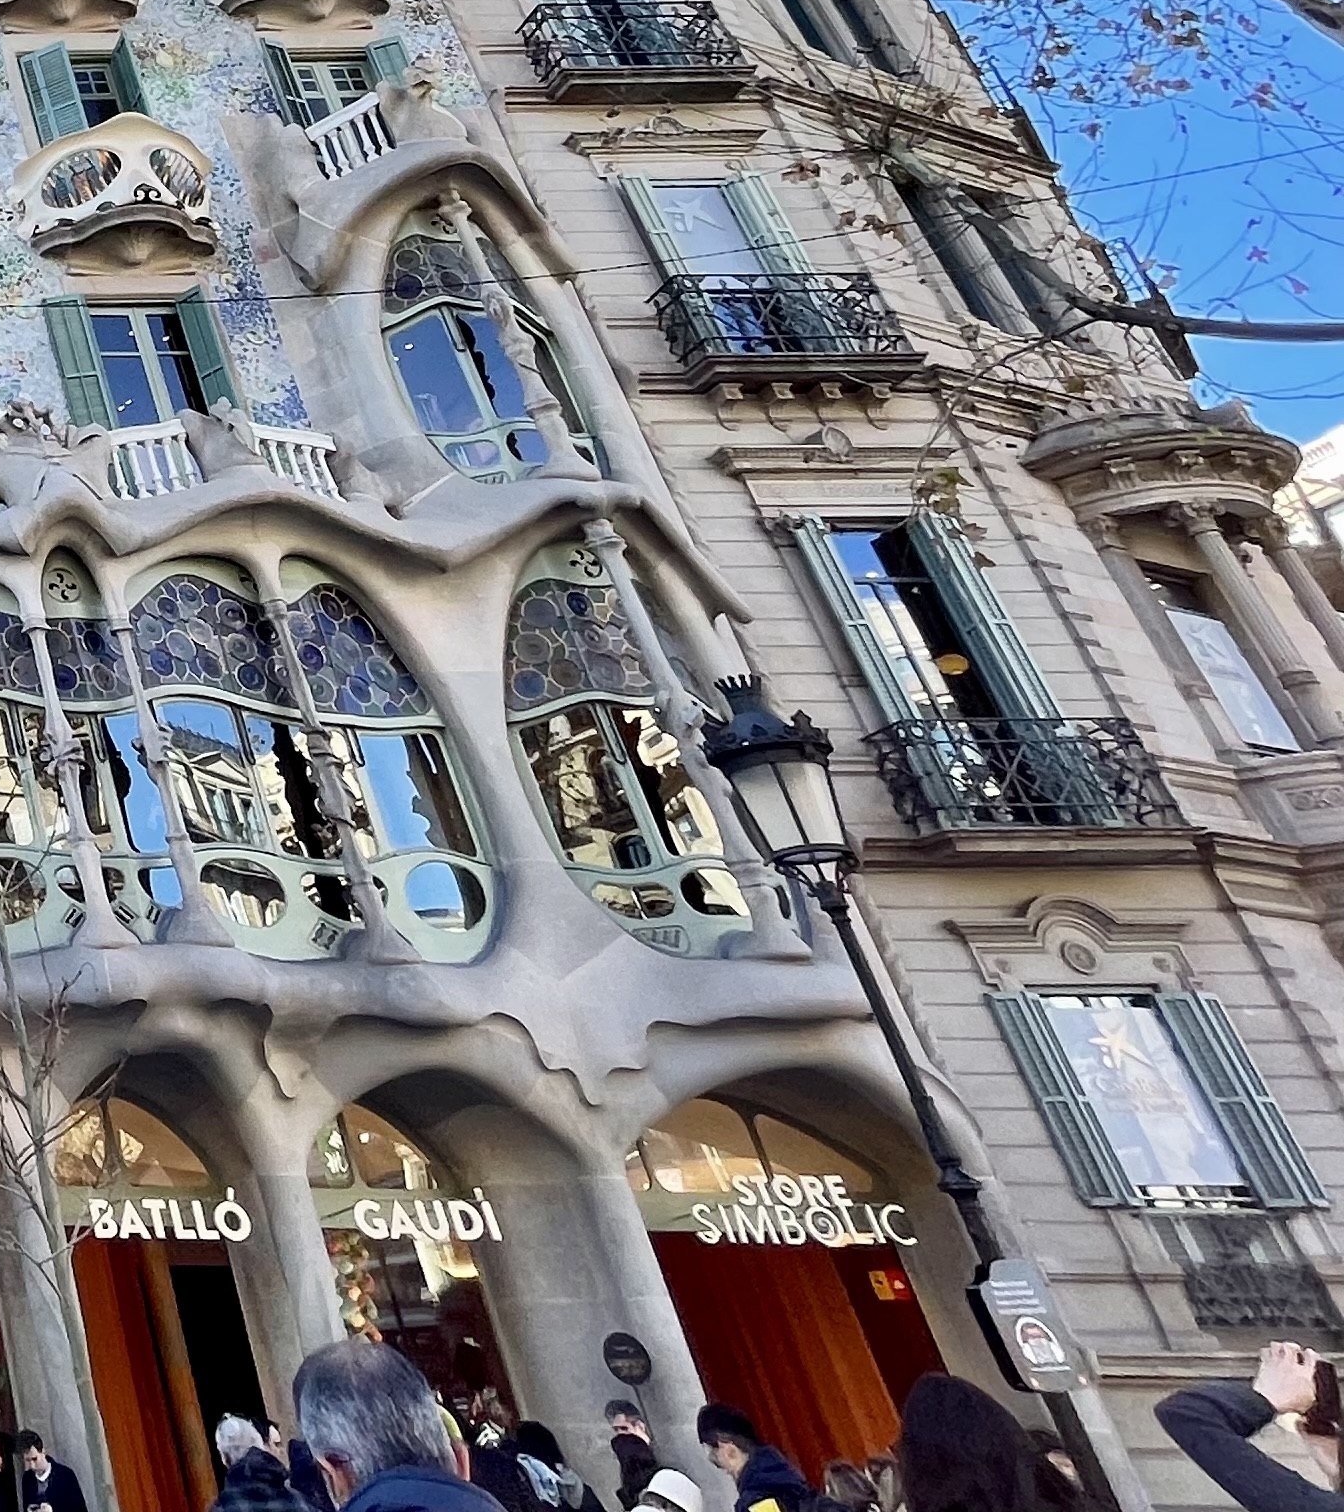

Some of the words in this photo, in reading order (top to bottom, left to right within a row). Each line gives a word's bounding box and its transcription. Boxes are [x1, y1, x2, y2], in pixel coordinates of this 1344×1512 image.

[732, 1174, 854, 1207] STORE
[88, 1186, 252, 1242] BATLLÓ
[353, 1186, 504, 1242] GAUDÍ
[691, 1203, 919, 1248] SIMBOLIC
